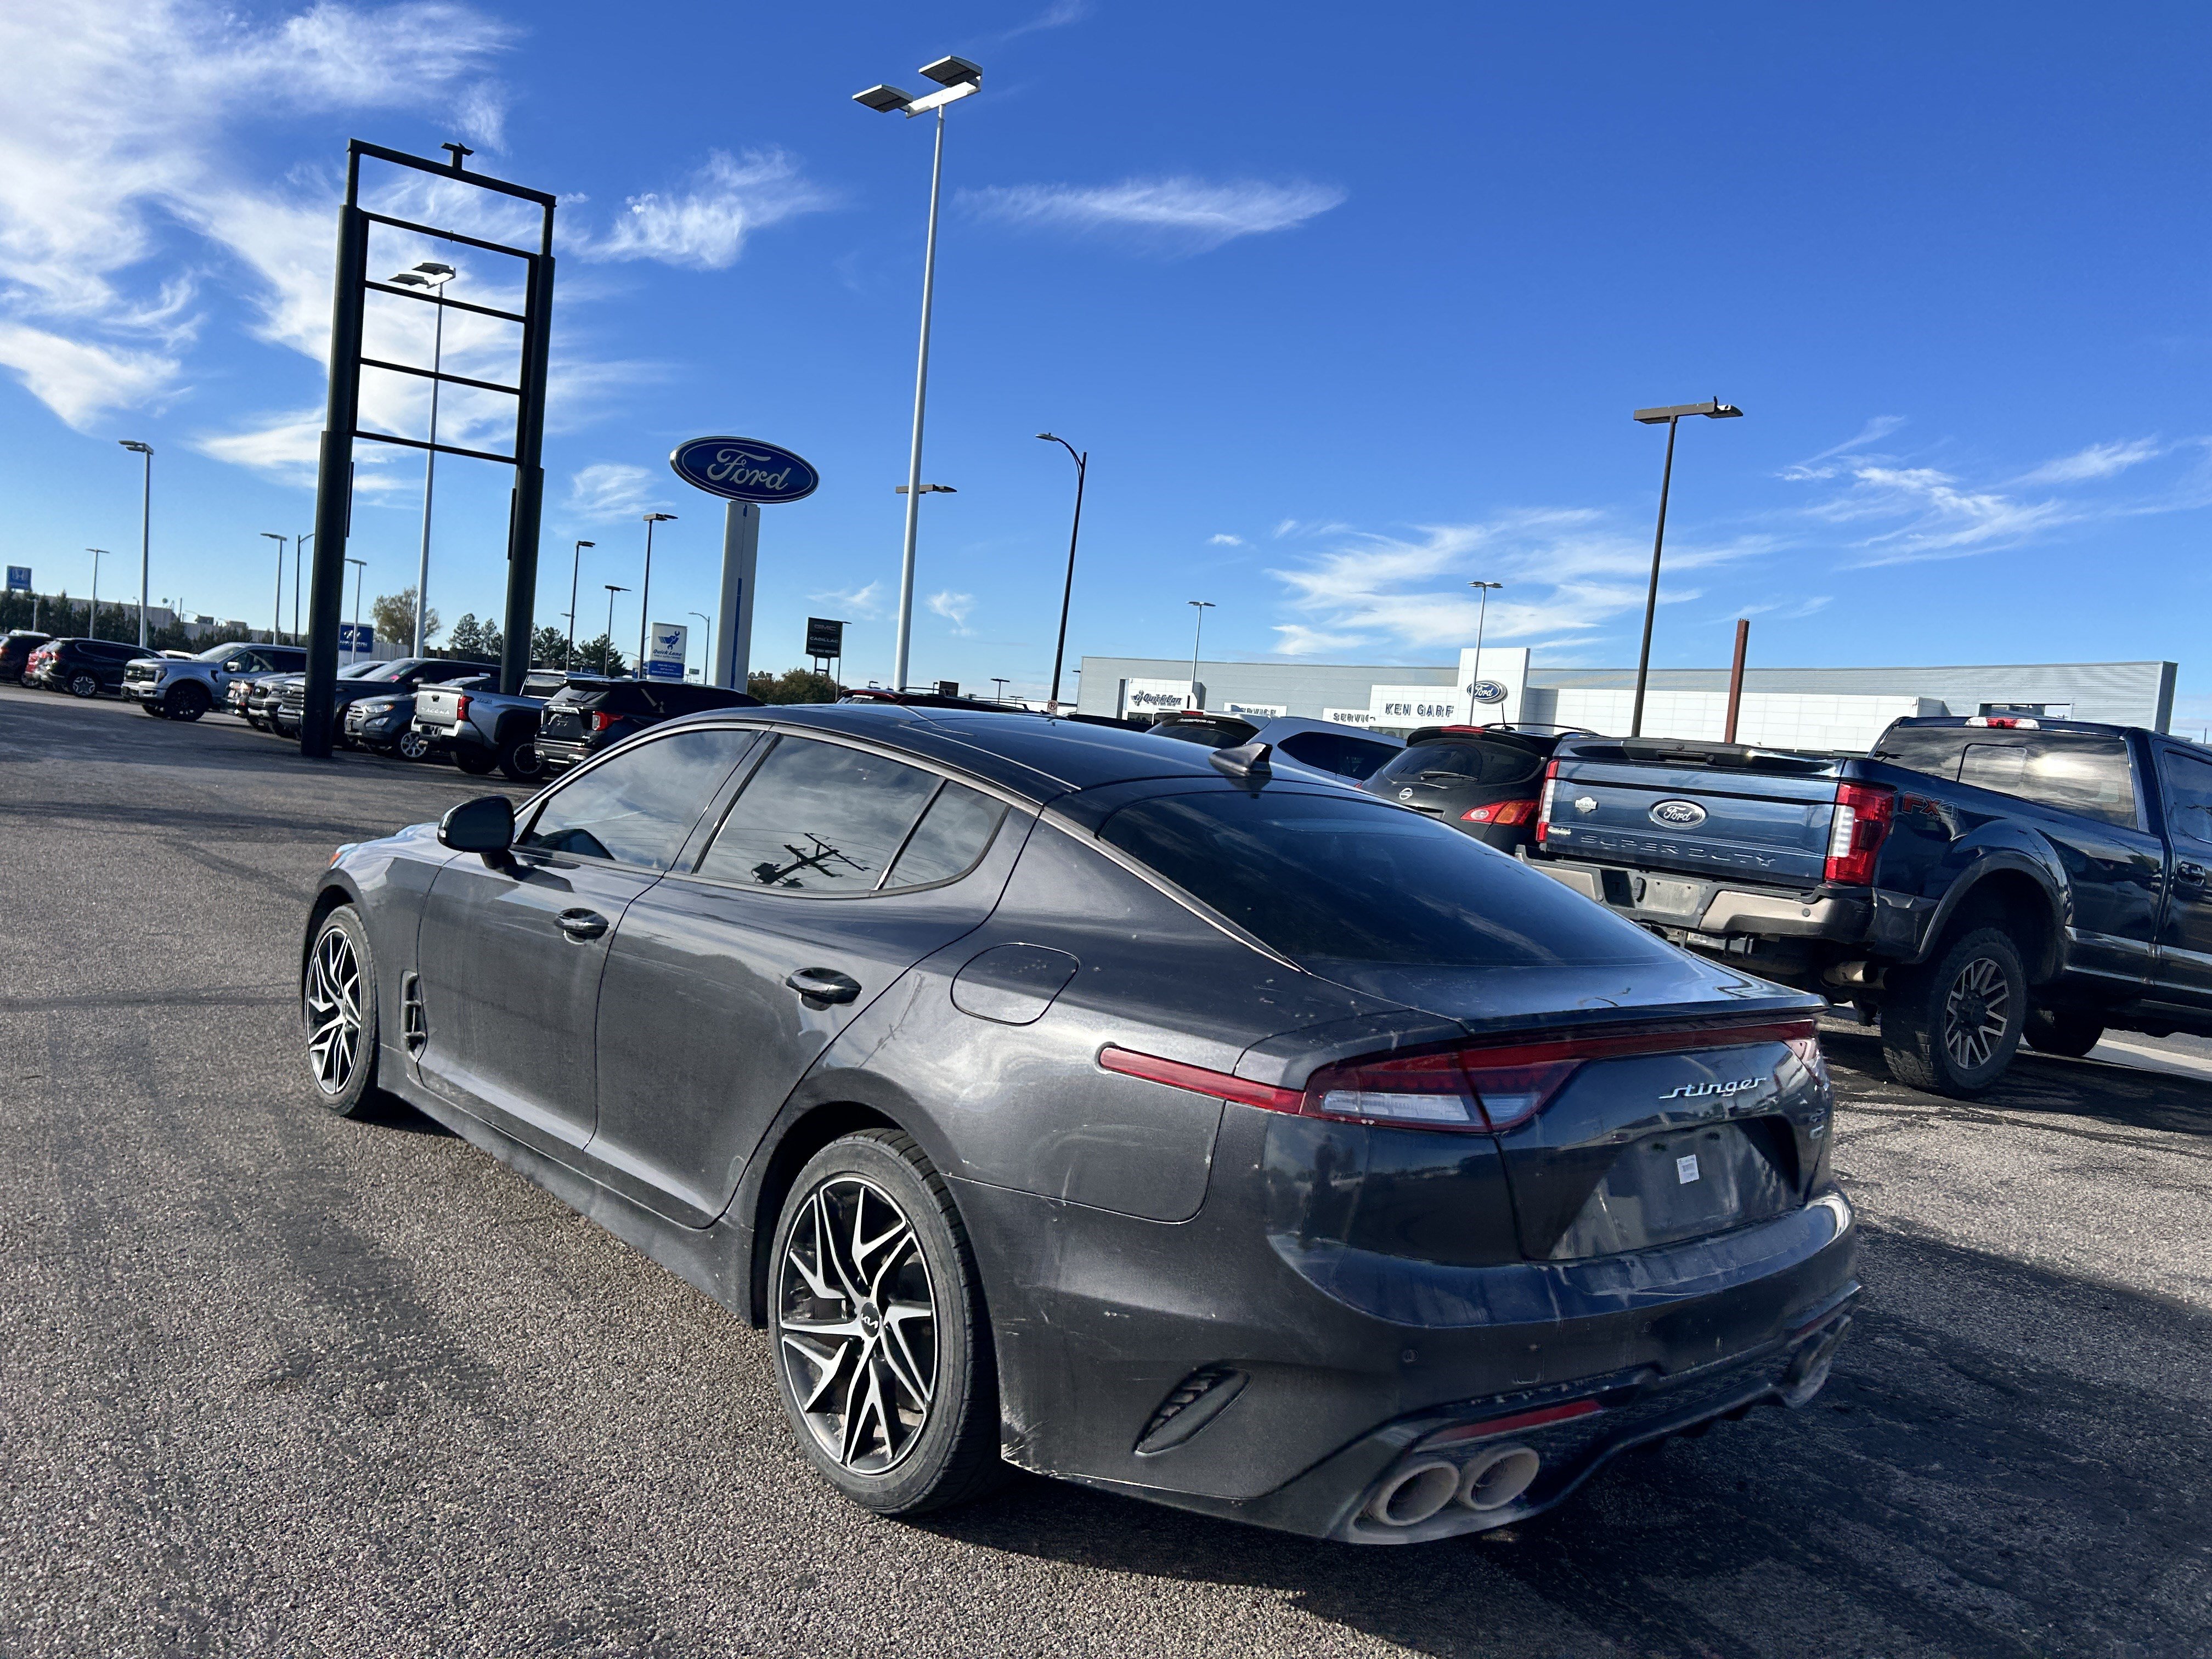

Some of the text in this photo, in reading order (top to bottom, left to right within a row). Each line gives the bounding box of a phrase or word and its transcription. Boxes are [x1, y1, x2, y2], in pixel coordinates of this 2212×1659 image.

[707, 449, 791, 490] Ford
[1474, 684, 1494, 696] Ford
[1385, 703, 1412, 716] KEN
[1663, 805, 1692, 821] Ford
[1902, 791, 1959, 821] FX4
[1581, 834, 1777, 867] SUPER DUTY
